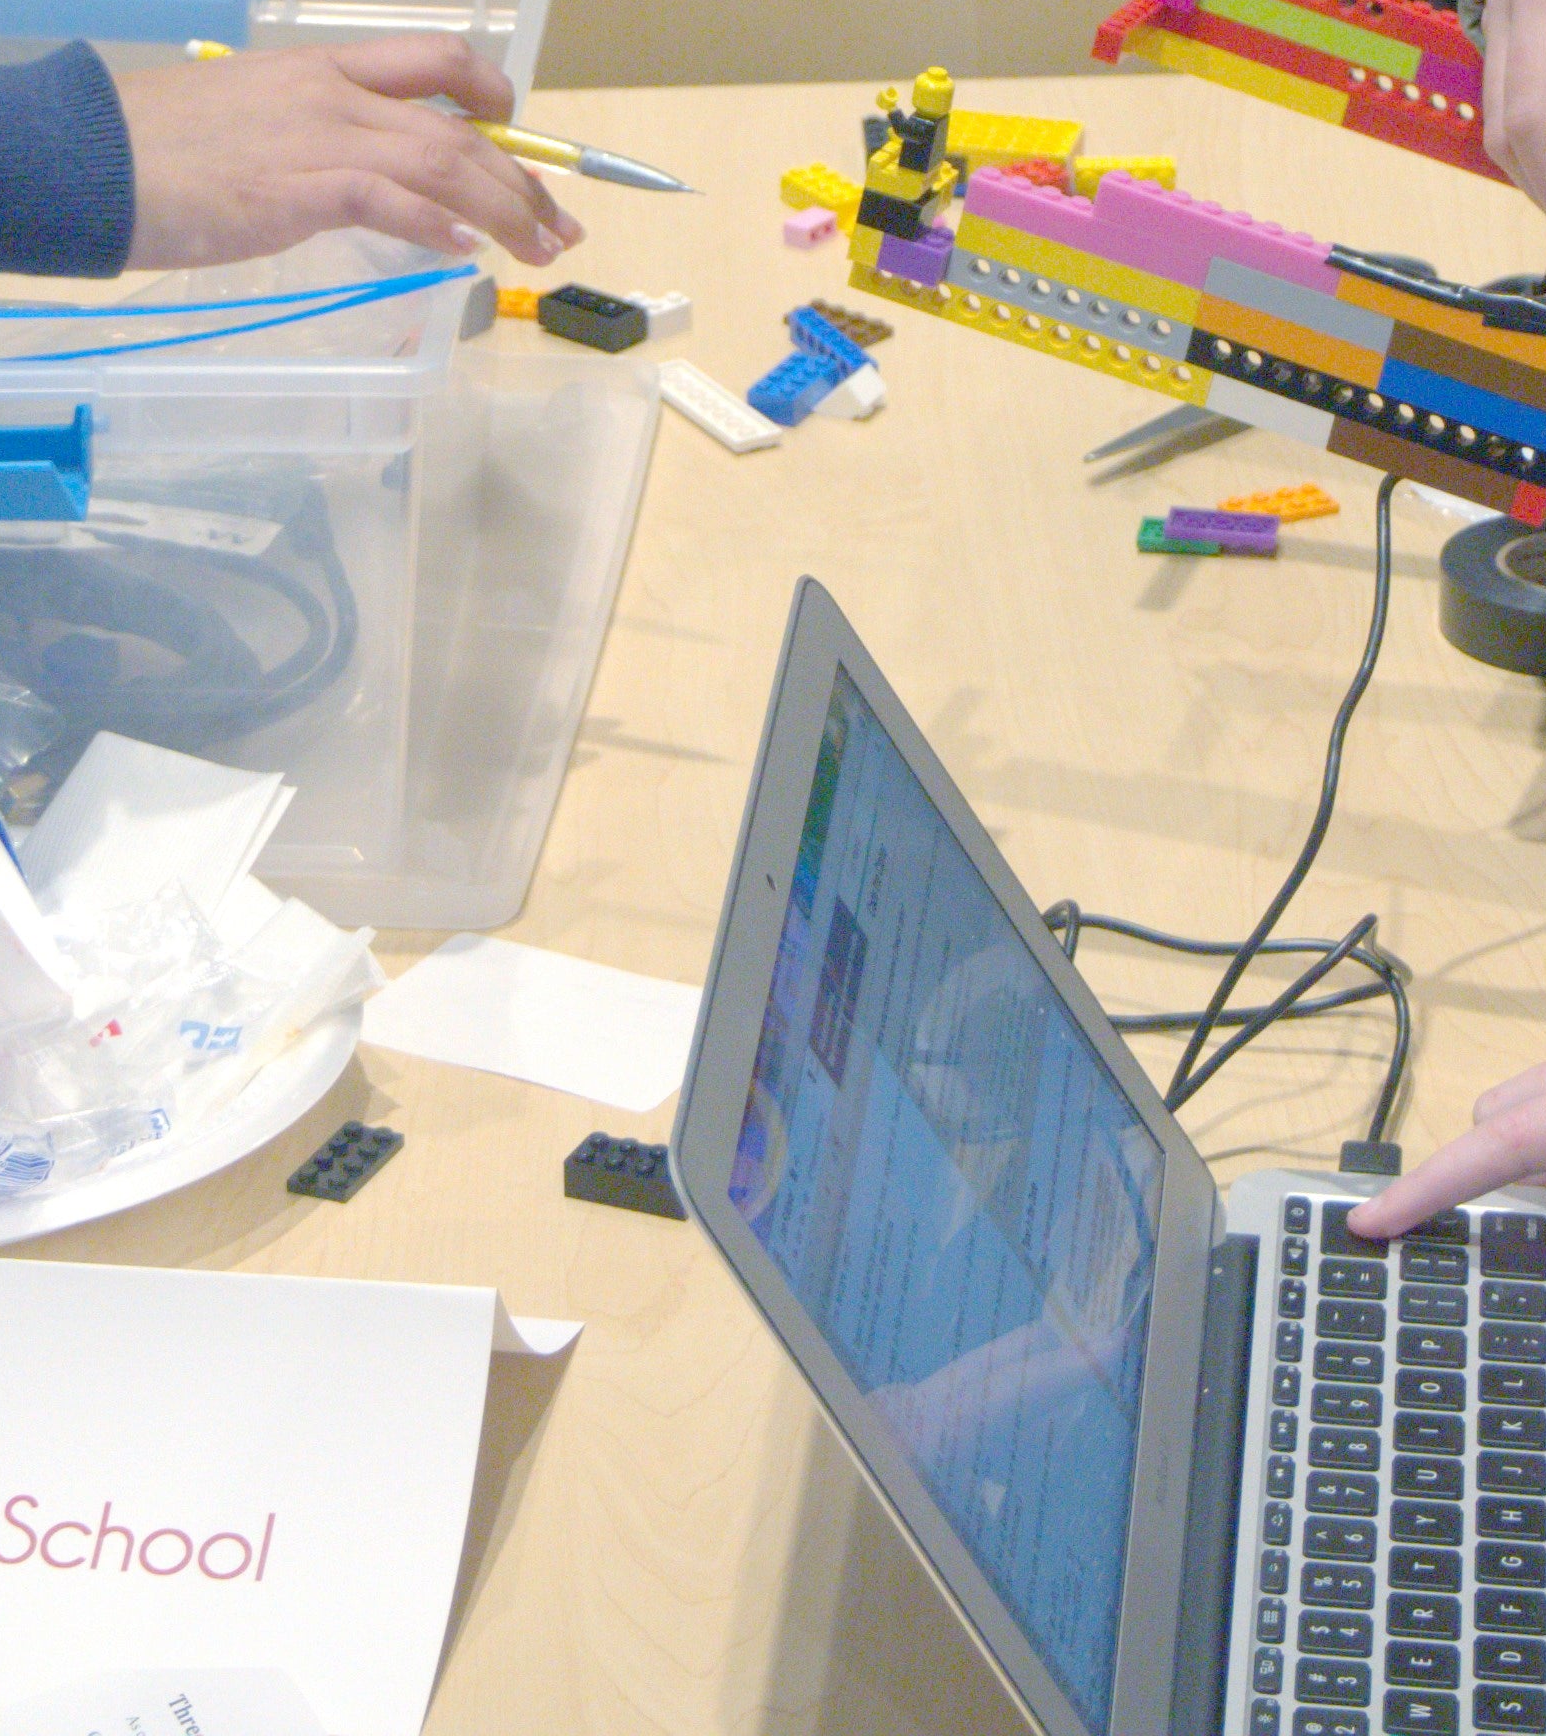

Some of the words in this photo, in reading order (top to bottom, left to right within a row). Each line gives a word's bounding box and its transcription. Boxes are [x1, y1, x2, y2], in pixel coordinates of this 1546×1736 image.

[1420, 1339, 1441, 1350] P
[1351, 1356, 1372, 1367] 0
[1419, 1381, 1441, 1394] O
[1502, 1378, 1524, 1388] L
[1350, 1399, 1370, 1409] 9
[1501, 1420, 1523, 1431] K
[1347, 1442, 1368, 1452] 8
[1416, 1468, 1439, 1481] U
[1501, 1465, 1523, 1475] J
[1344, 1486, 1366, 1496] 7
[1415, 1514, 1437, 1525] Y
[1501, 1509, 1522, 1522] H
[1344, 1533, 1364, 1543] 6
[1413, 1561, 1435, 1571] T
[1500, 1555, 1523, 1568] G
[1341, 1579, 1363, 1589] 5
[1412, 1608, 1434, 1619] R
[1499, 1603, 1522, 1614] F
[1339, 1627, 1359, 1638] 4
[1410, 1656, 1433, 1667] E
[1499, 1650, 1522, 1663] D
[1336, 1676, 1358, 1686] 3
[1409, 1703, 1432, 1718] W
[1499, 1701, 1523, 1712] S
